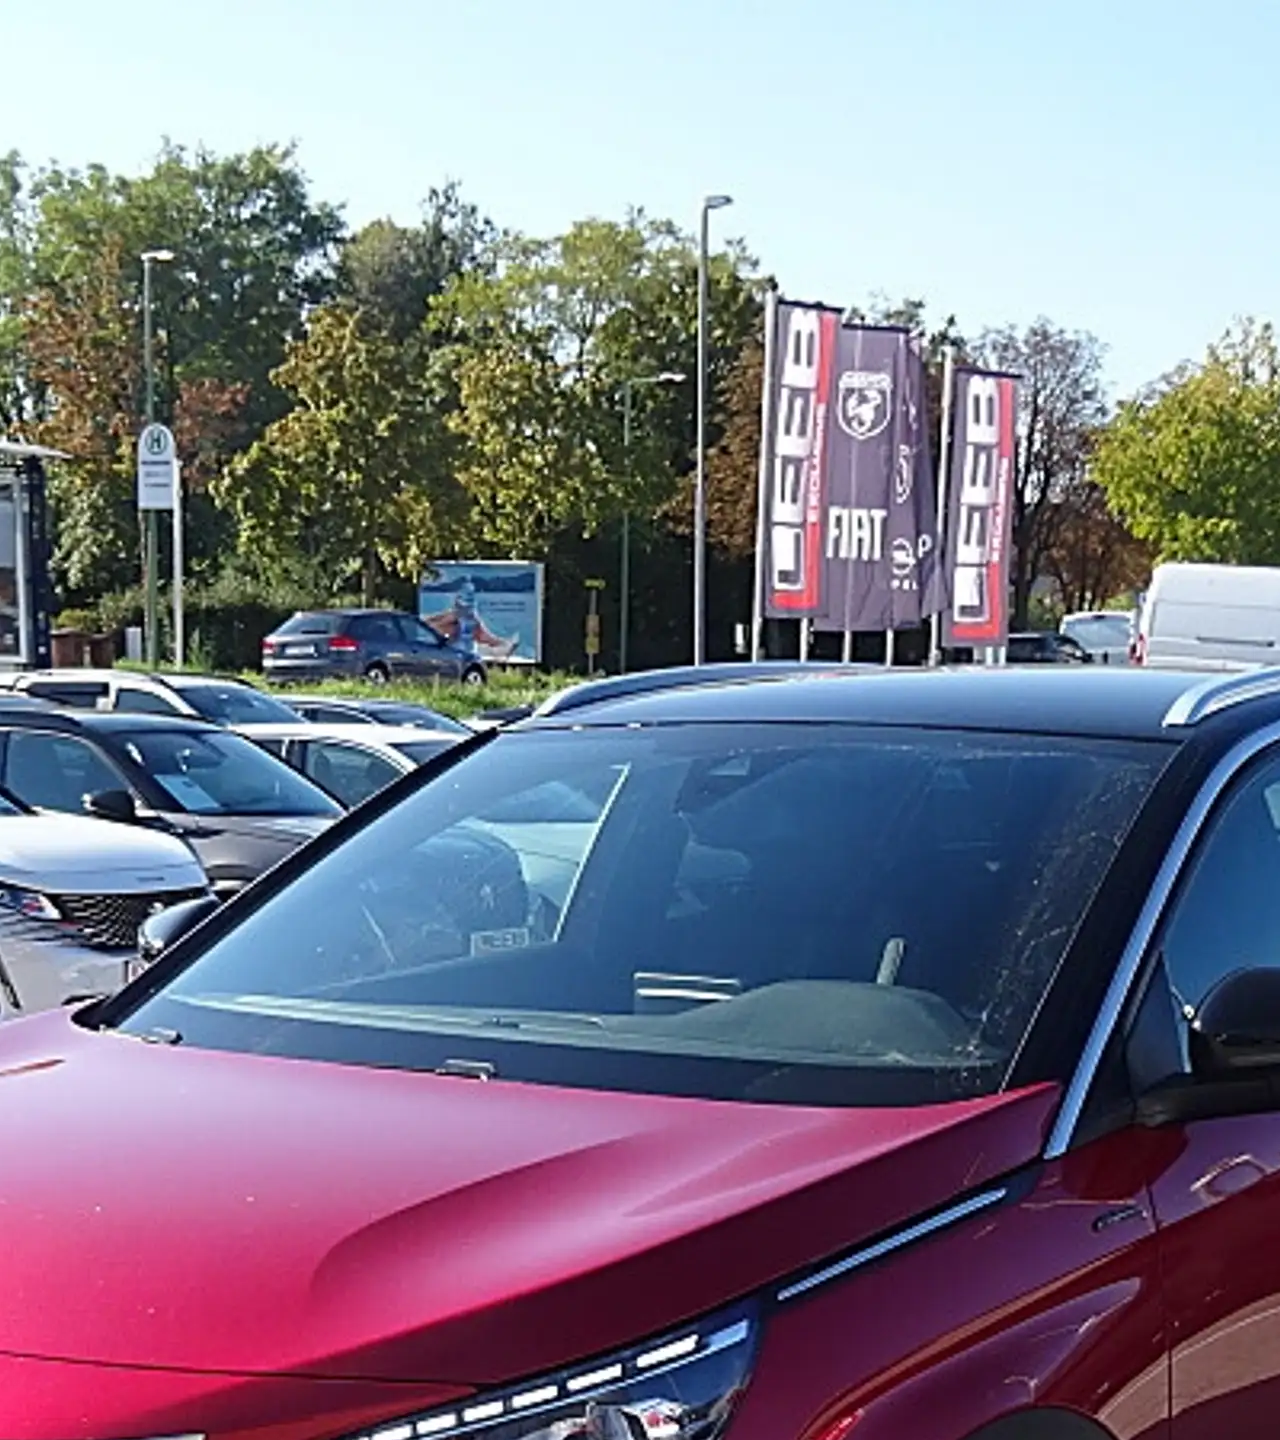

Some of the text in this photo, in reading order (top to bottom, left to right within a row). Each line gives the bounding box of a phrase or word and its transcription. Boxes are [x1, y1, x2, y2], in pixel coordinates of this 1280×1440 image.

[772, 308, 821, 590] LEEB
[826, 506, 887, 561] FIAT
[953, 377, 999, 622] LEEB
